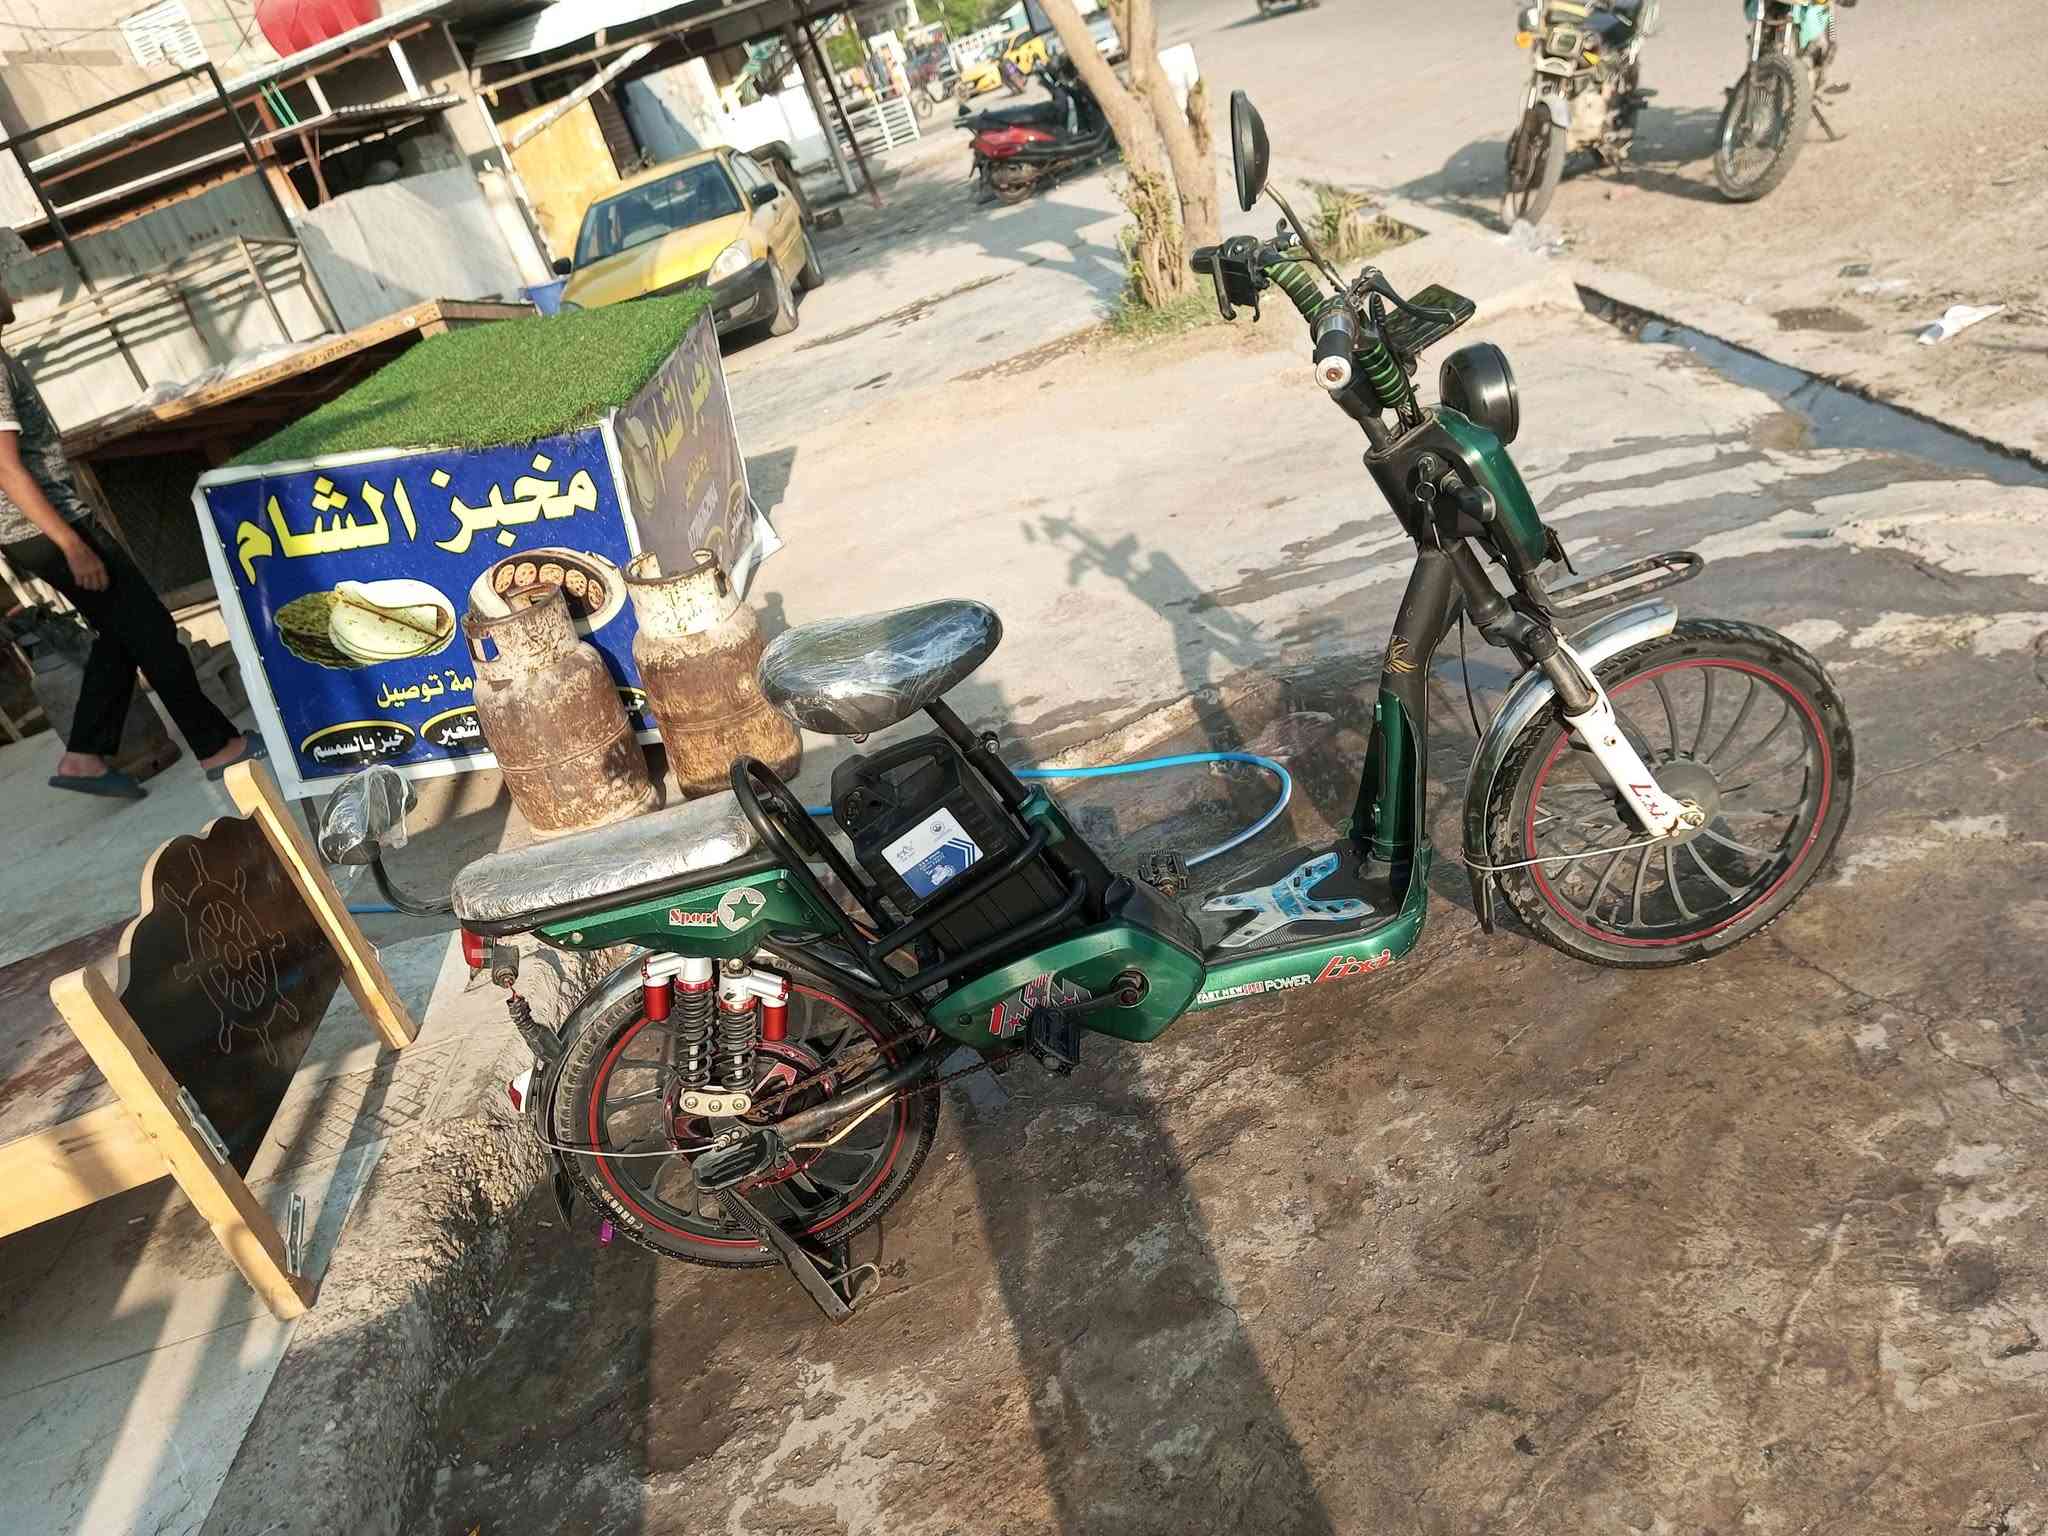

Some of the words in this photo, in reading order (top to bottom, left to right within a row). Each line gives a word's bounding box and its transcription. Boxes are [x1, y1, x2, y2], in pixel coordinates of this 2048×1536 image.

[430, 453, 598, 554] مخبز
[236, 475, 418, 585] الشام
[377, 674, 444, 708] توصيل
[448, 669, 474, 693] مة
[378, 729, 404, 753] خبز
[437, 716, 480, 746] شعير
[313, 735, 377, 763] بالسمسم
[669, 908, 719, 926] Sport
[1265, 974, 1312, 992] POWER
